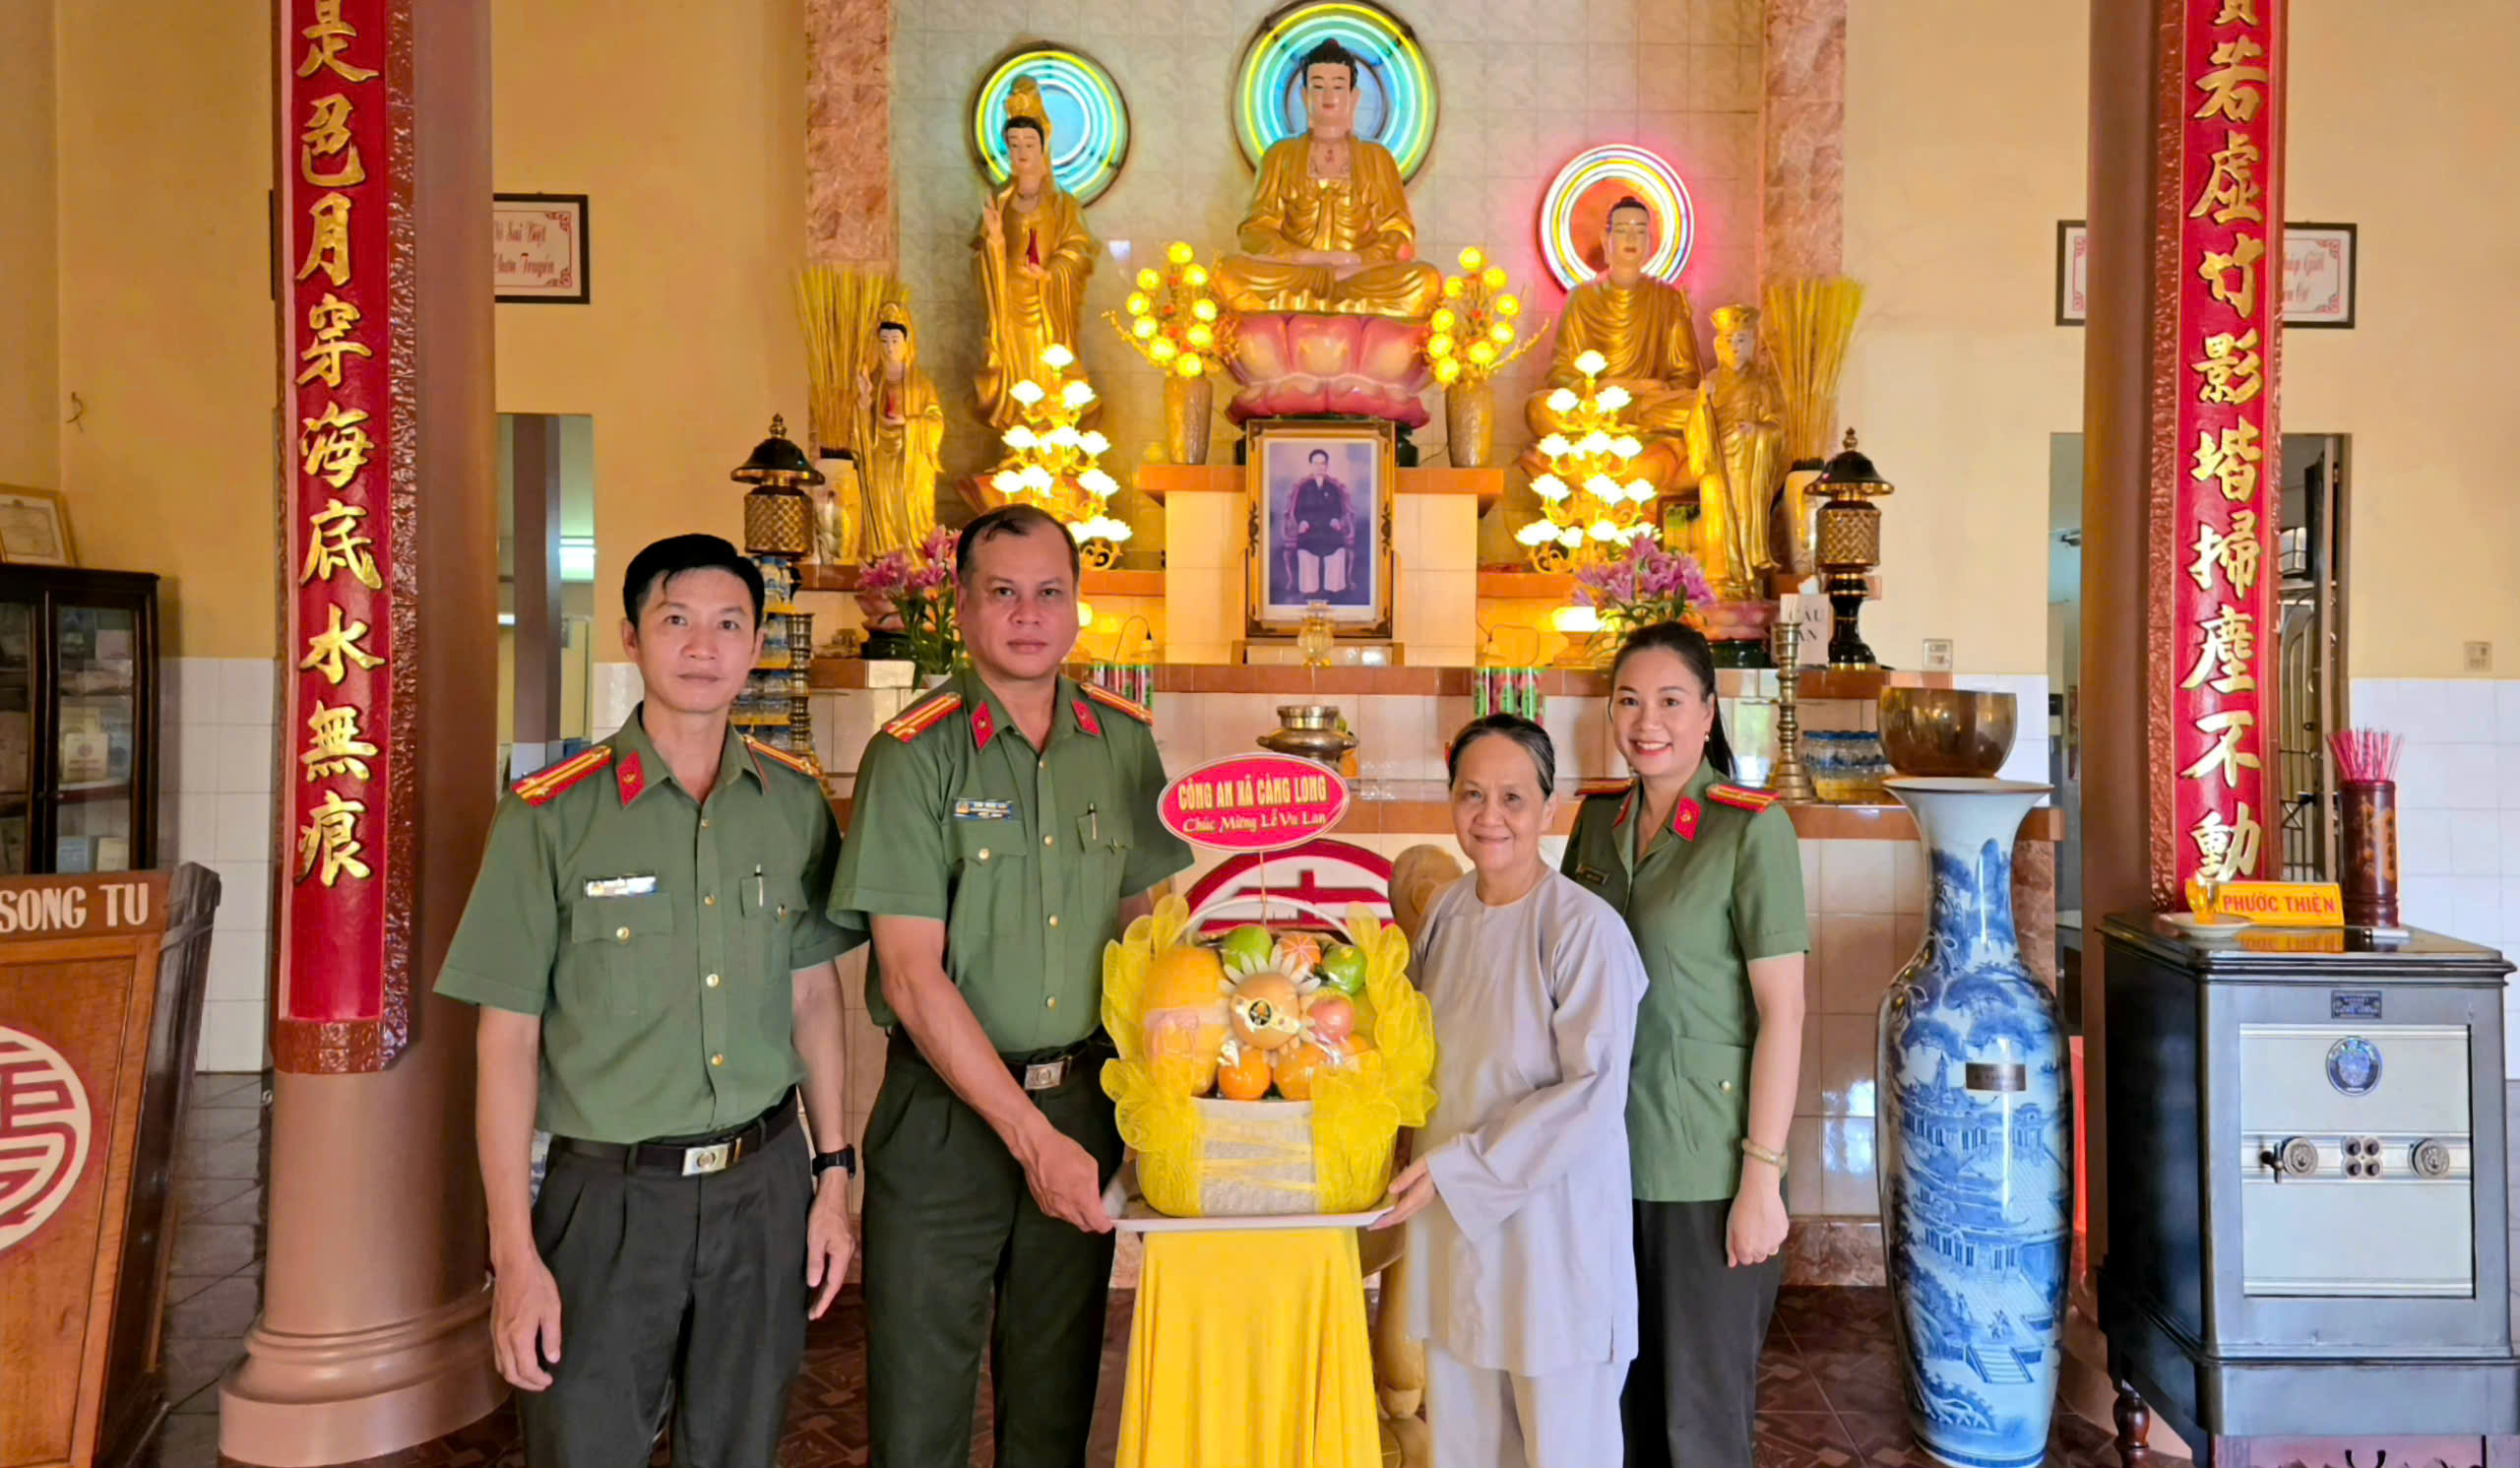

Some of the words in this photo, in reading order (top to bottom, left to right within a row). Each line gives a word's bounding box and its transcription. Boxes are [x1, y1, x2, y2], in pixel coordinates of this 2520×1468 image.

[1217, 781, 1234, 808] AN
[1257, 772, 1292, 805] CÀNG
[1294, 775, 1327, 803] LONG
[1280, 811, 1298, 826] Vu
[1301, 810, 1327, 826] Lan
[0, 886, 87, 933] SONG
[98, 883, 149, 927] TU
[2223, 892, 2279, 913] PHƯỚC
[2284, 892, 2336, 916] THIỆN
